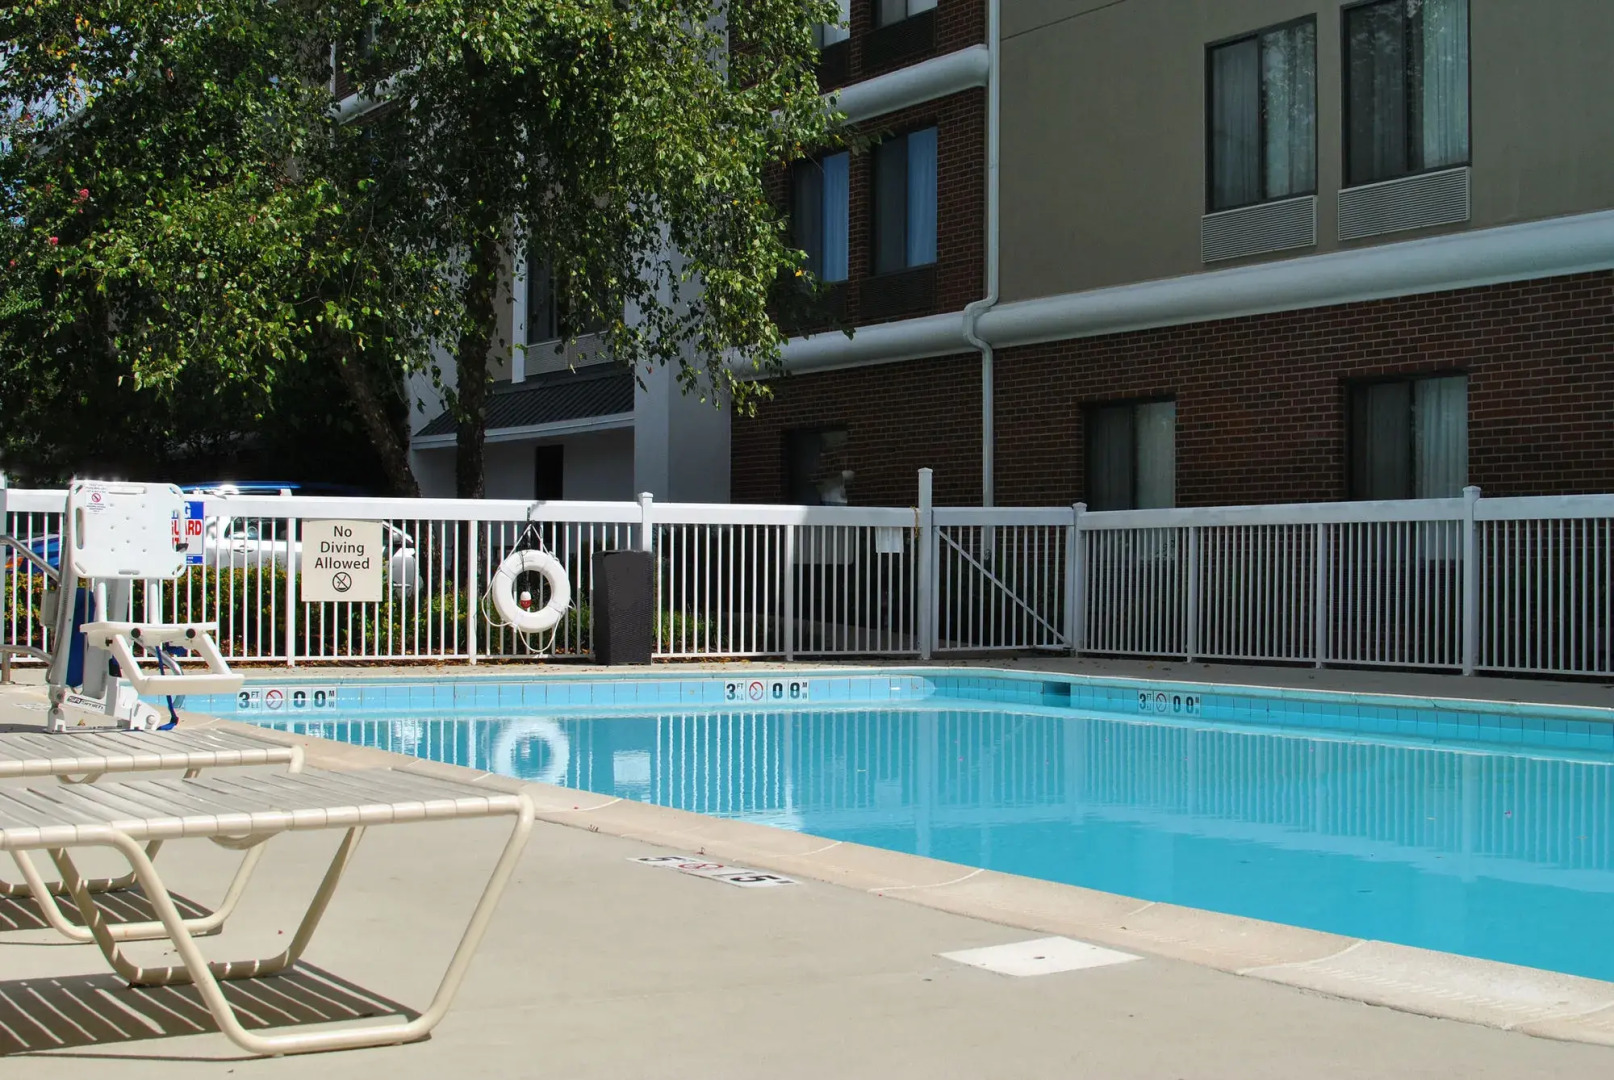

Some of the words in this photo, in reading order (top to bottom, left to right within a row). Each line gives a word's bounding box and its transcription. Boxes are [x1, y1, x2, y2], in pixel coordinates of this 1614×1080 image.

[333, 525, 353, 538] No
[320, 541, 365, 557] Diving
[314, 557, 370, 570] Allowed
[726, 683, 736, 700] 3
[238, 691, 251, 709] 3
[1139, 693, 1147, 710] 3
